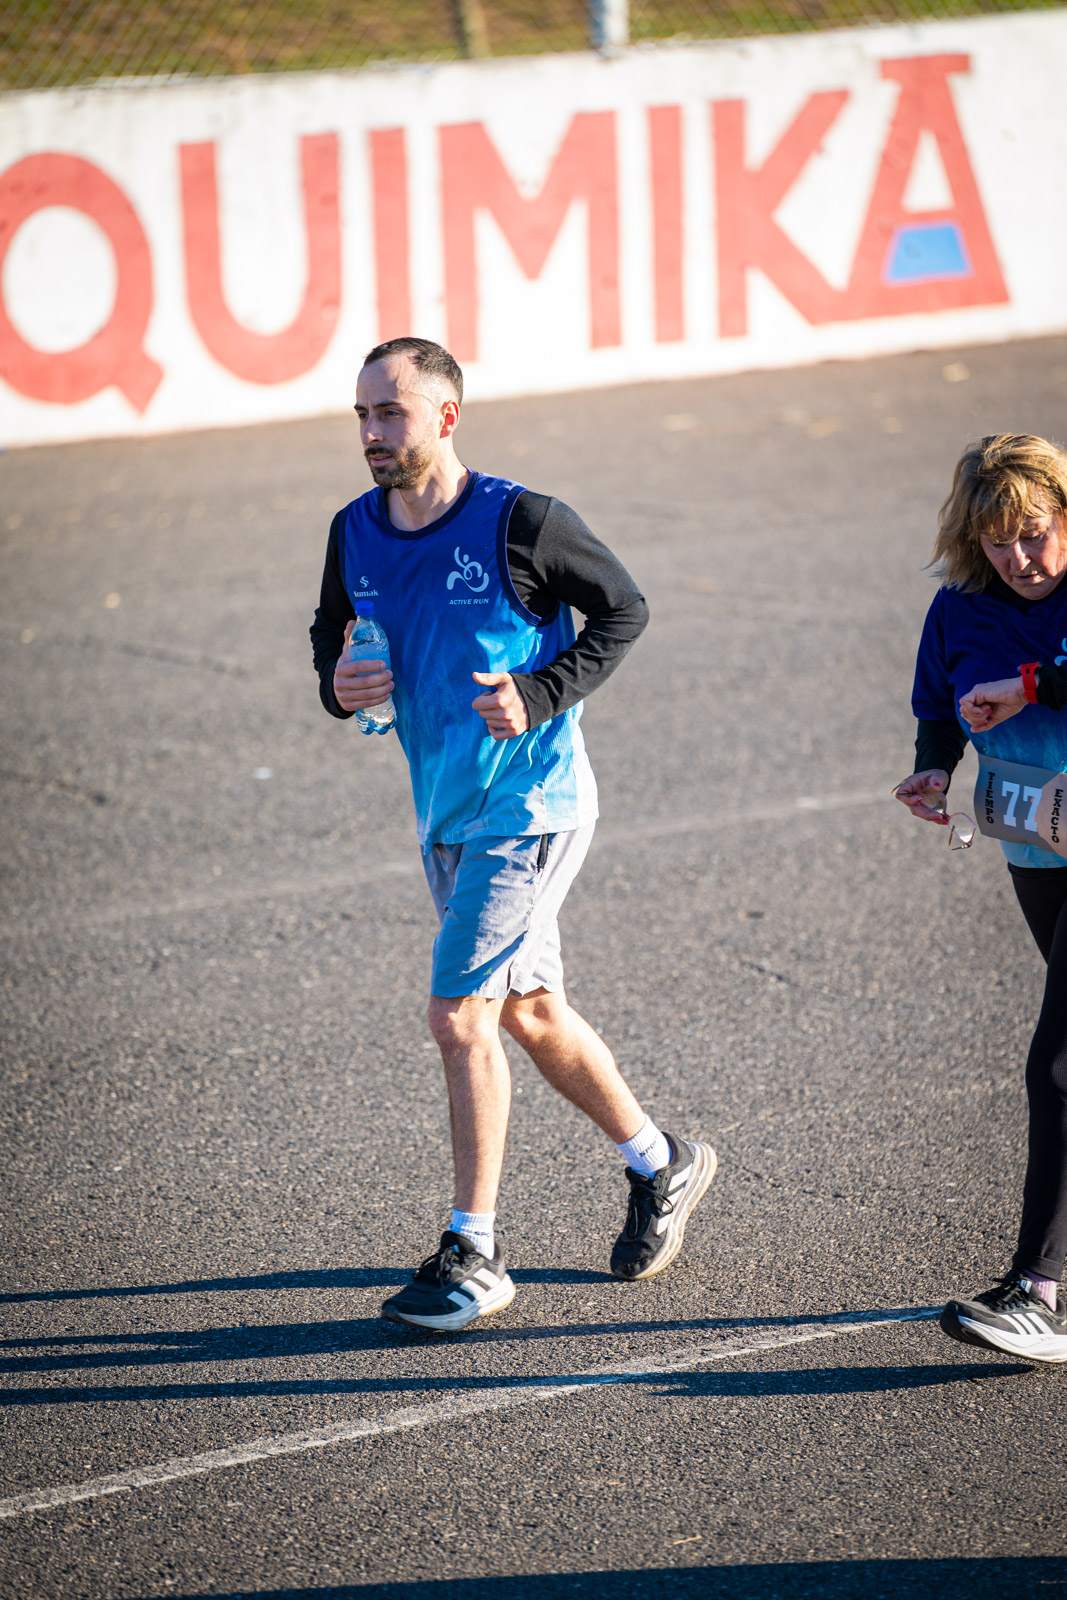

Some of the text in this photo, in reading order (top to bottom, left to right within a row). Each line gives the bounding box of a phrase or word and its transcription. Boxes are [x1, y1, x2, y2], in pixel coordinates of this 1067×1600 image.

[0, 53, 1010, 415] QUIMIKA
[353, 589, 379, 598] Sumak
[985, 771, 996, 825] TIEMPO
[1001, 780, 1043, 833] 77
[1050, 788, 1064, 844] EXACTO
